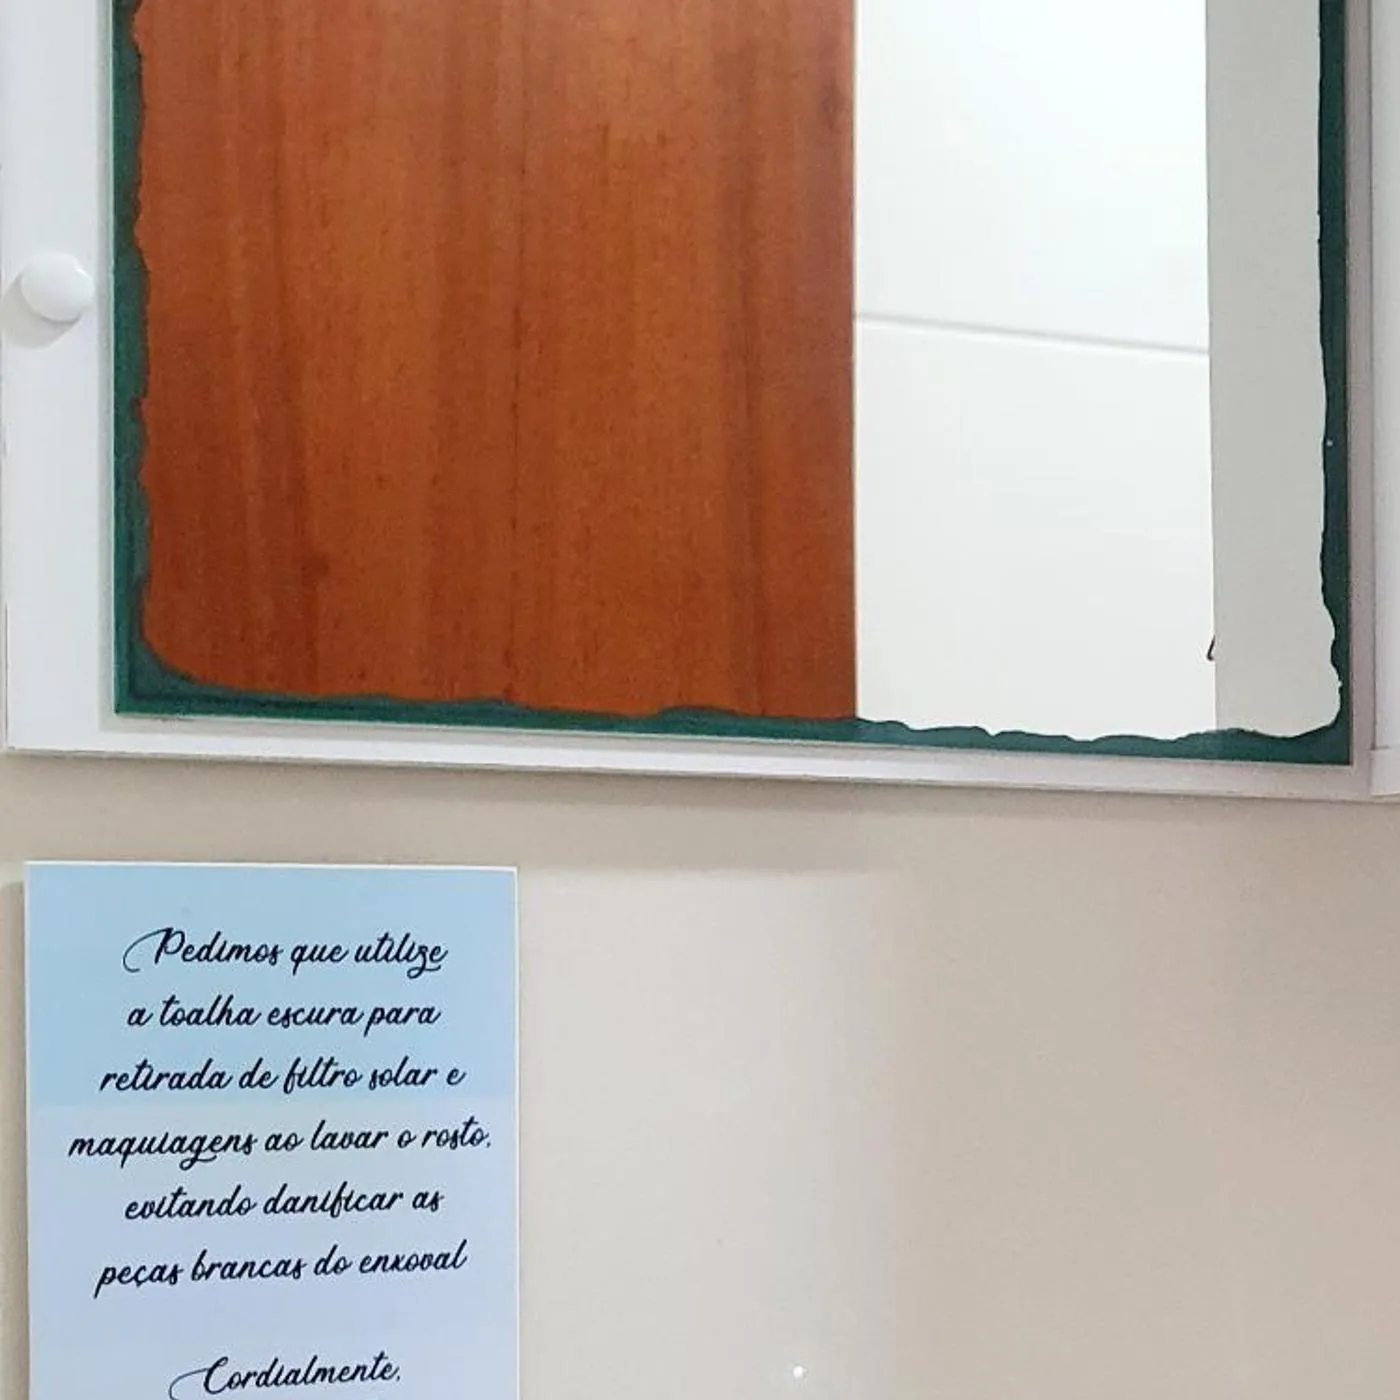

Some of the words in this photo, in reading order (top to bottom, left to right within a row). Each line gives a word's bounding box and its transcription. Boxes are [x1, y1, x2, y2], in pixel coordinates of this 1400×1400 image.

[123, 927, 284, 973] Pedimos
[291, 944, 349, 976] que
[354, 932, 448, 979] utilize
[127, 1008, 153, 1027] a
[159, 994, 262, 1027] toalha
[267, 1007, 364, 1029] escura
[363, 1007, 441, 1037] para
[99, 1058, 233, 1091] retirada
[239, 1057, 279, 1089] de
[283, 1057, 363, 1094] filtro
[369, 1056, 437, 1090] solar
[446, 1068, 466, 1086] e
[68, 1132, 258, 1171] maquiagens
[265, 1133, 304, 1152] ao
[310, 1120, 389, 1150] lavar
[397, 1130, 417, 1148] o
[125, 1184, 257, 1219] evitando
[263, 1181, 403, 1218] danificar
[412, 1191, 444, 1212] as
[94, 1264, 184, 1299] peças
[191, 1249, 307, 1281] brancas
[313, 1244, 353, 1275] do
[359, 1239, 467, 1273] enxoval
